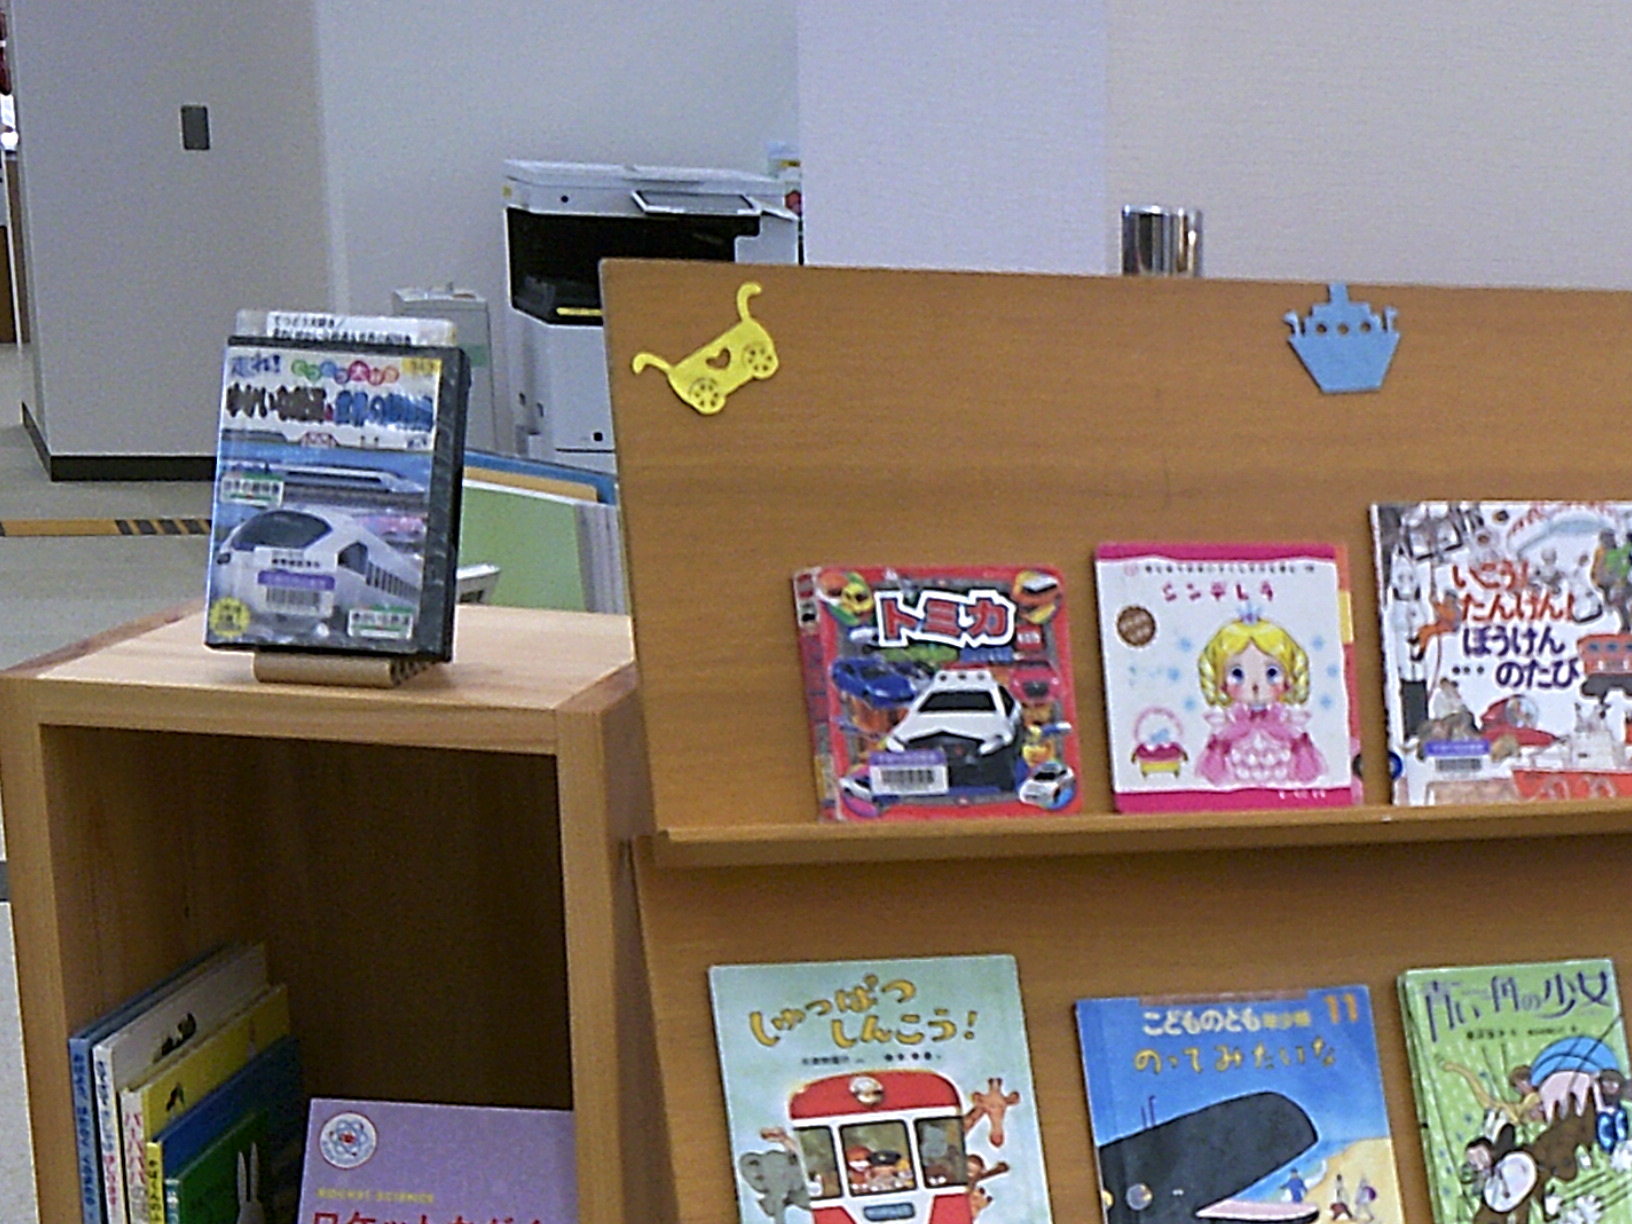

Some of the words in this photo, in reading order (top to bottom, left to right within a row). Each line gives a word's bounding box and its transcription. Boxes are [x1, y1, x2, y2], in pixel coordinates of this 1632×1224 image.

[877, 592, 1013, 644] トミカ
[1495, 657, 1582, 689] のたび
[749, 973, 918, 1048] しゅっぱつ
[831, 1008, 979, 1049] しんこう!
[1142, 1008, 1261, 1036] こどものとも
[1324, 993, 1359, 1024] 11
